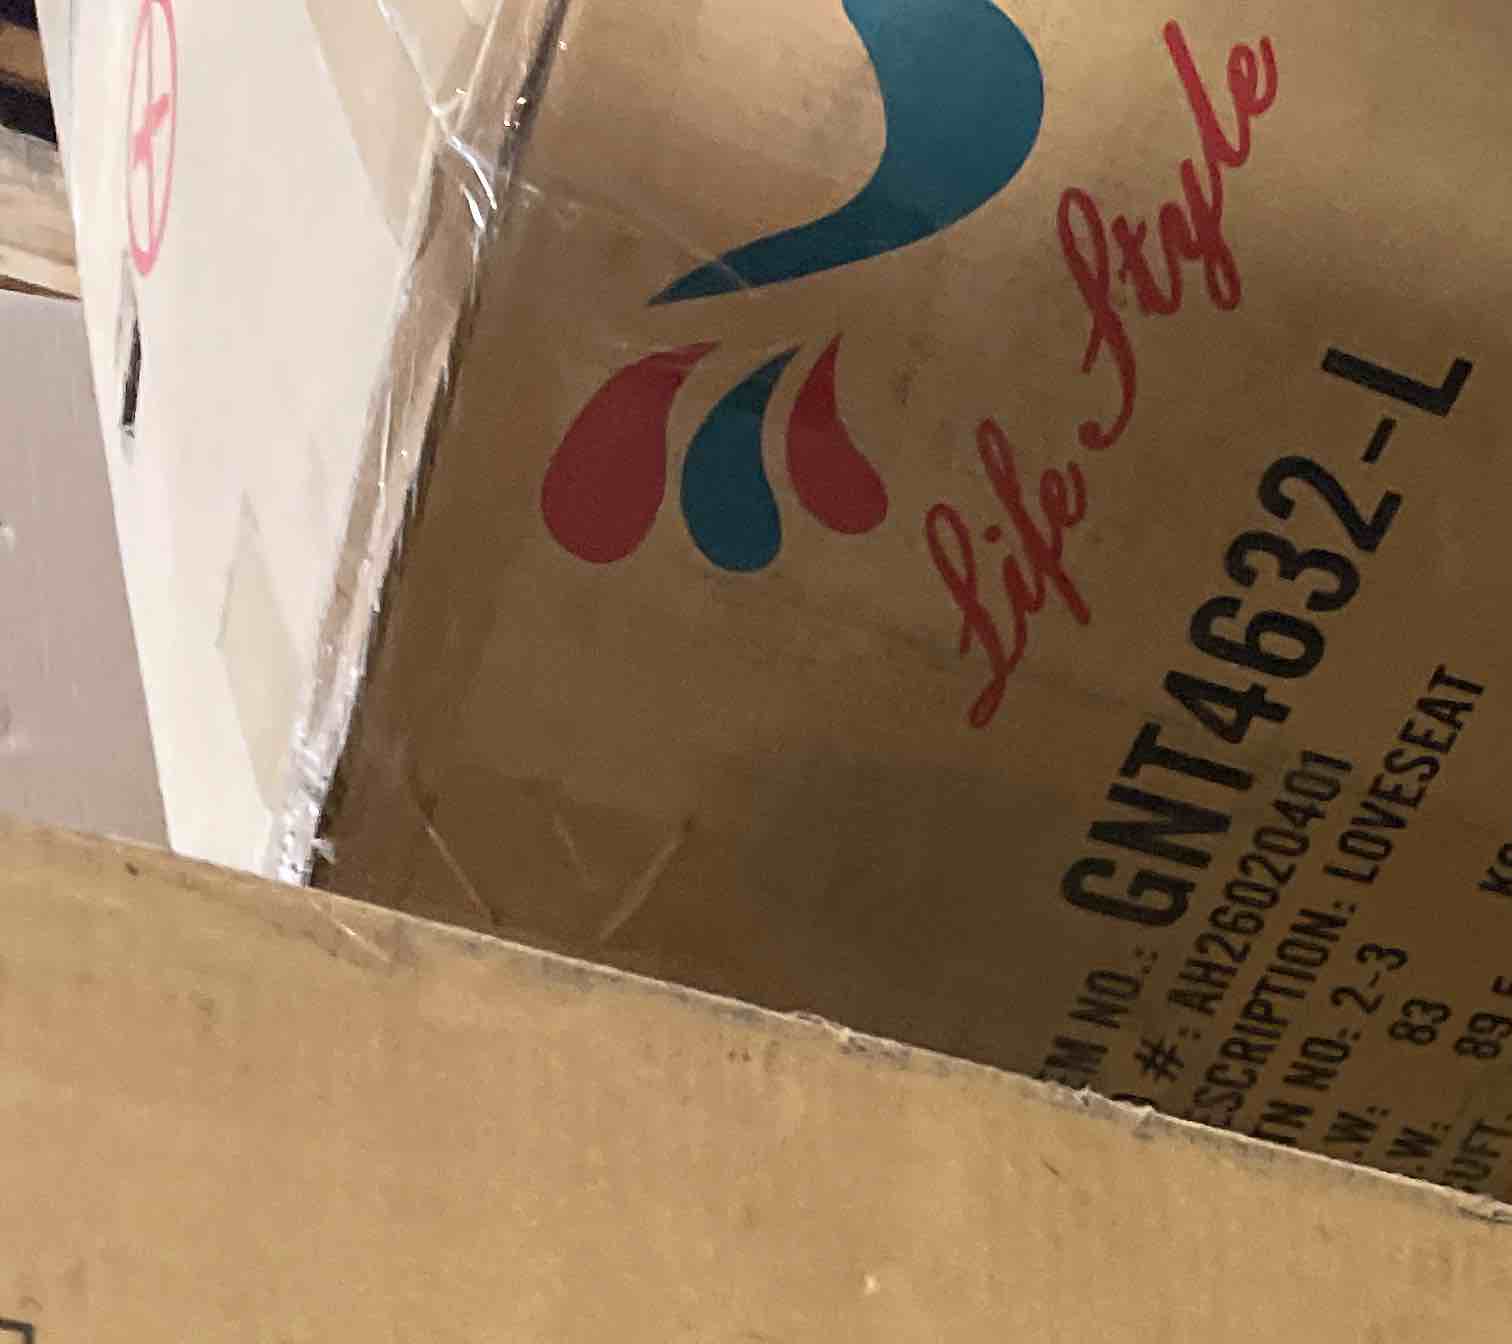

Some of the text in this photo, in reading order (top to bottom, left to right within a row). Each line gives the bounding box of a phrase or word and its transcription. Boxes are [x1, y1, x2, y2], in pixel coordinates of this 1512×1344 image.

[924, 18, 1279, 729] Life Style
[1059, 346, 1474, 929] GNT4632-L
[1166, 749, 1354, 1017] AH26020401
[1322, 664, 1485, 885] LOVESEAT
[1329, 942, 1408, 1013] 2-3
[1386, 998, 1452, 1046] 83
